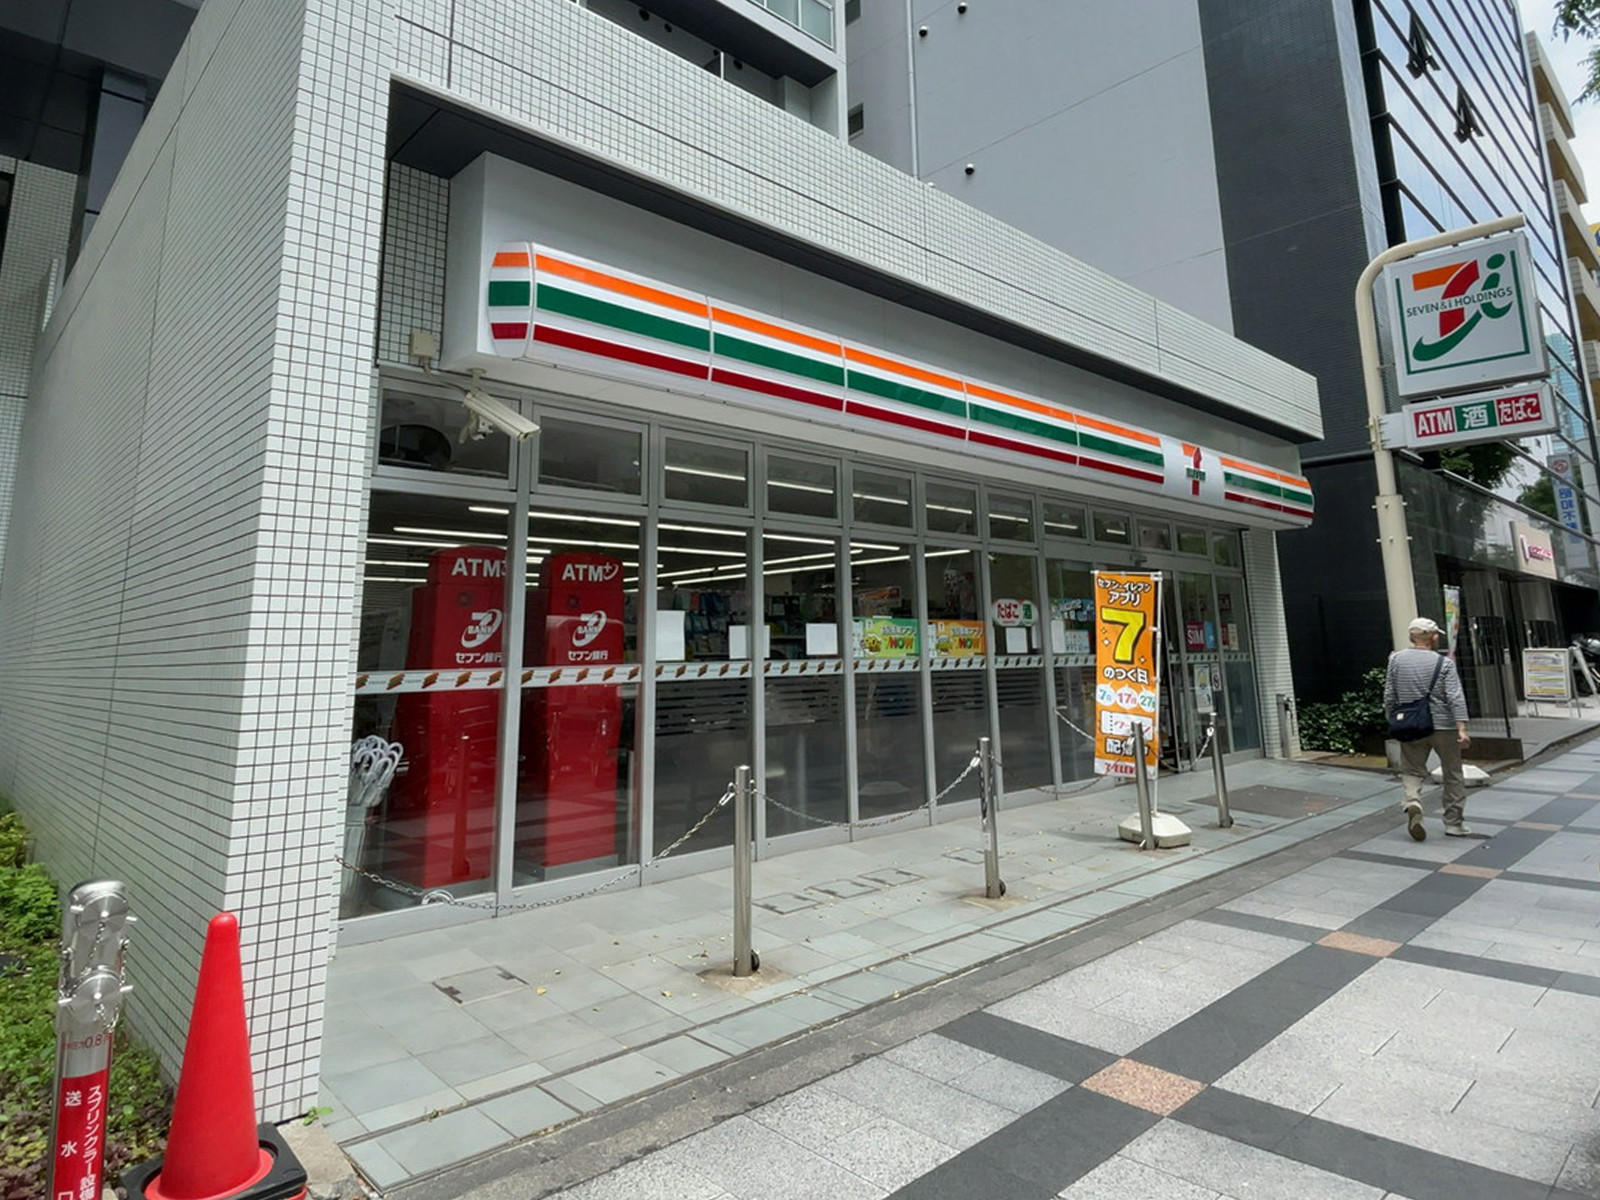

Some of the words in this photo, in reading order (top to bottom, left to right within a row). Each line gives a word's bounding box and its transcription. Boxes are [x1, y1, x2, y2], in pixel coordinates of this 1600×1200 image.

[1455, 286, 1513, 307] HOLDINGS
[1417, 409, 1454, 436] ATM
[1462, 404, 1490, 430] 酒
[1497, 396, 1541, 424] たばこ
[1108, 590, 1141, 607] アプリ
[1100, 607, 1146, 664] 7
[567, 649, 609, 661] セブン銀行
[1103, 666, 1149, 685] のつく日
